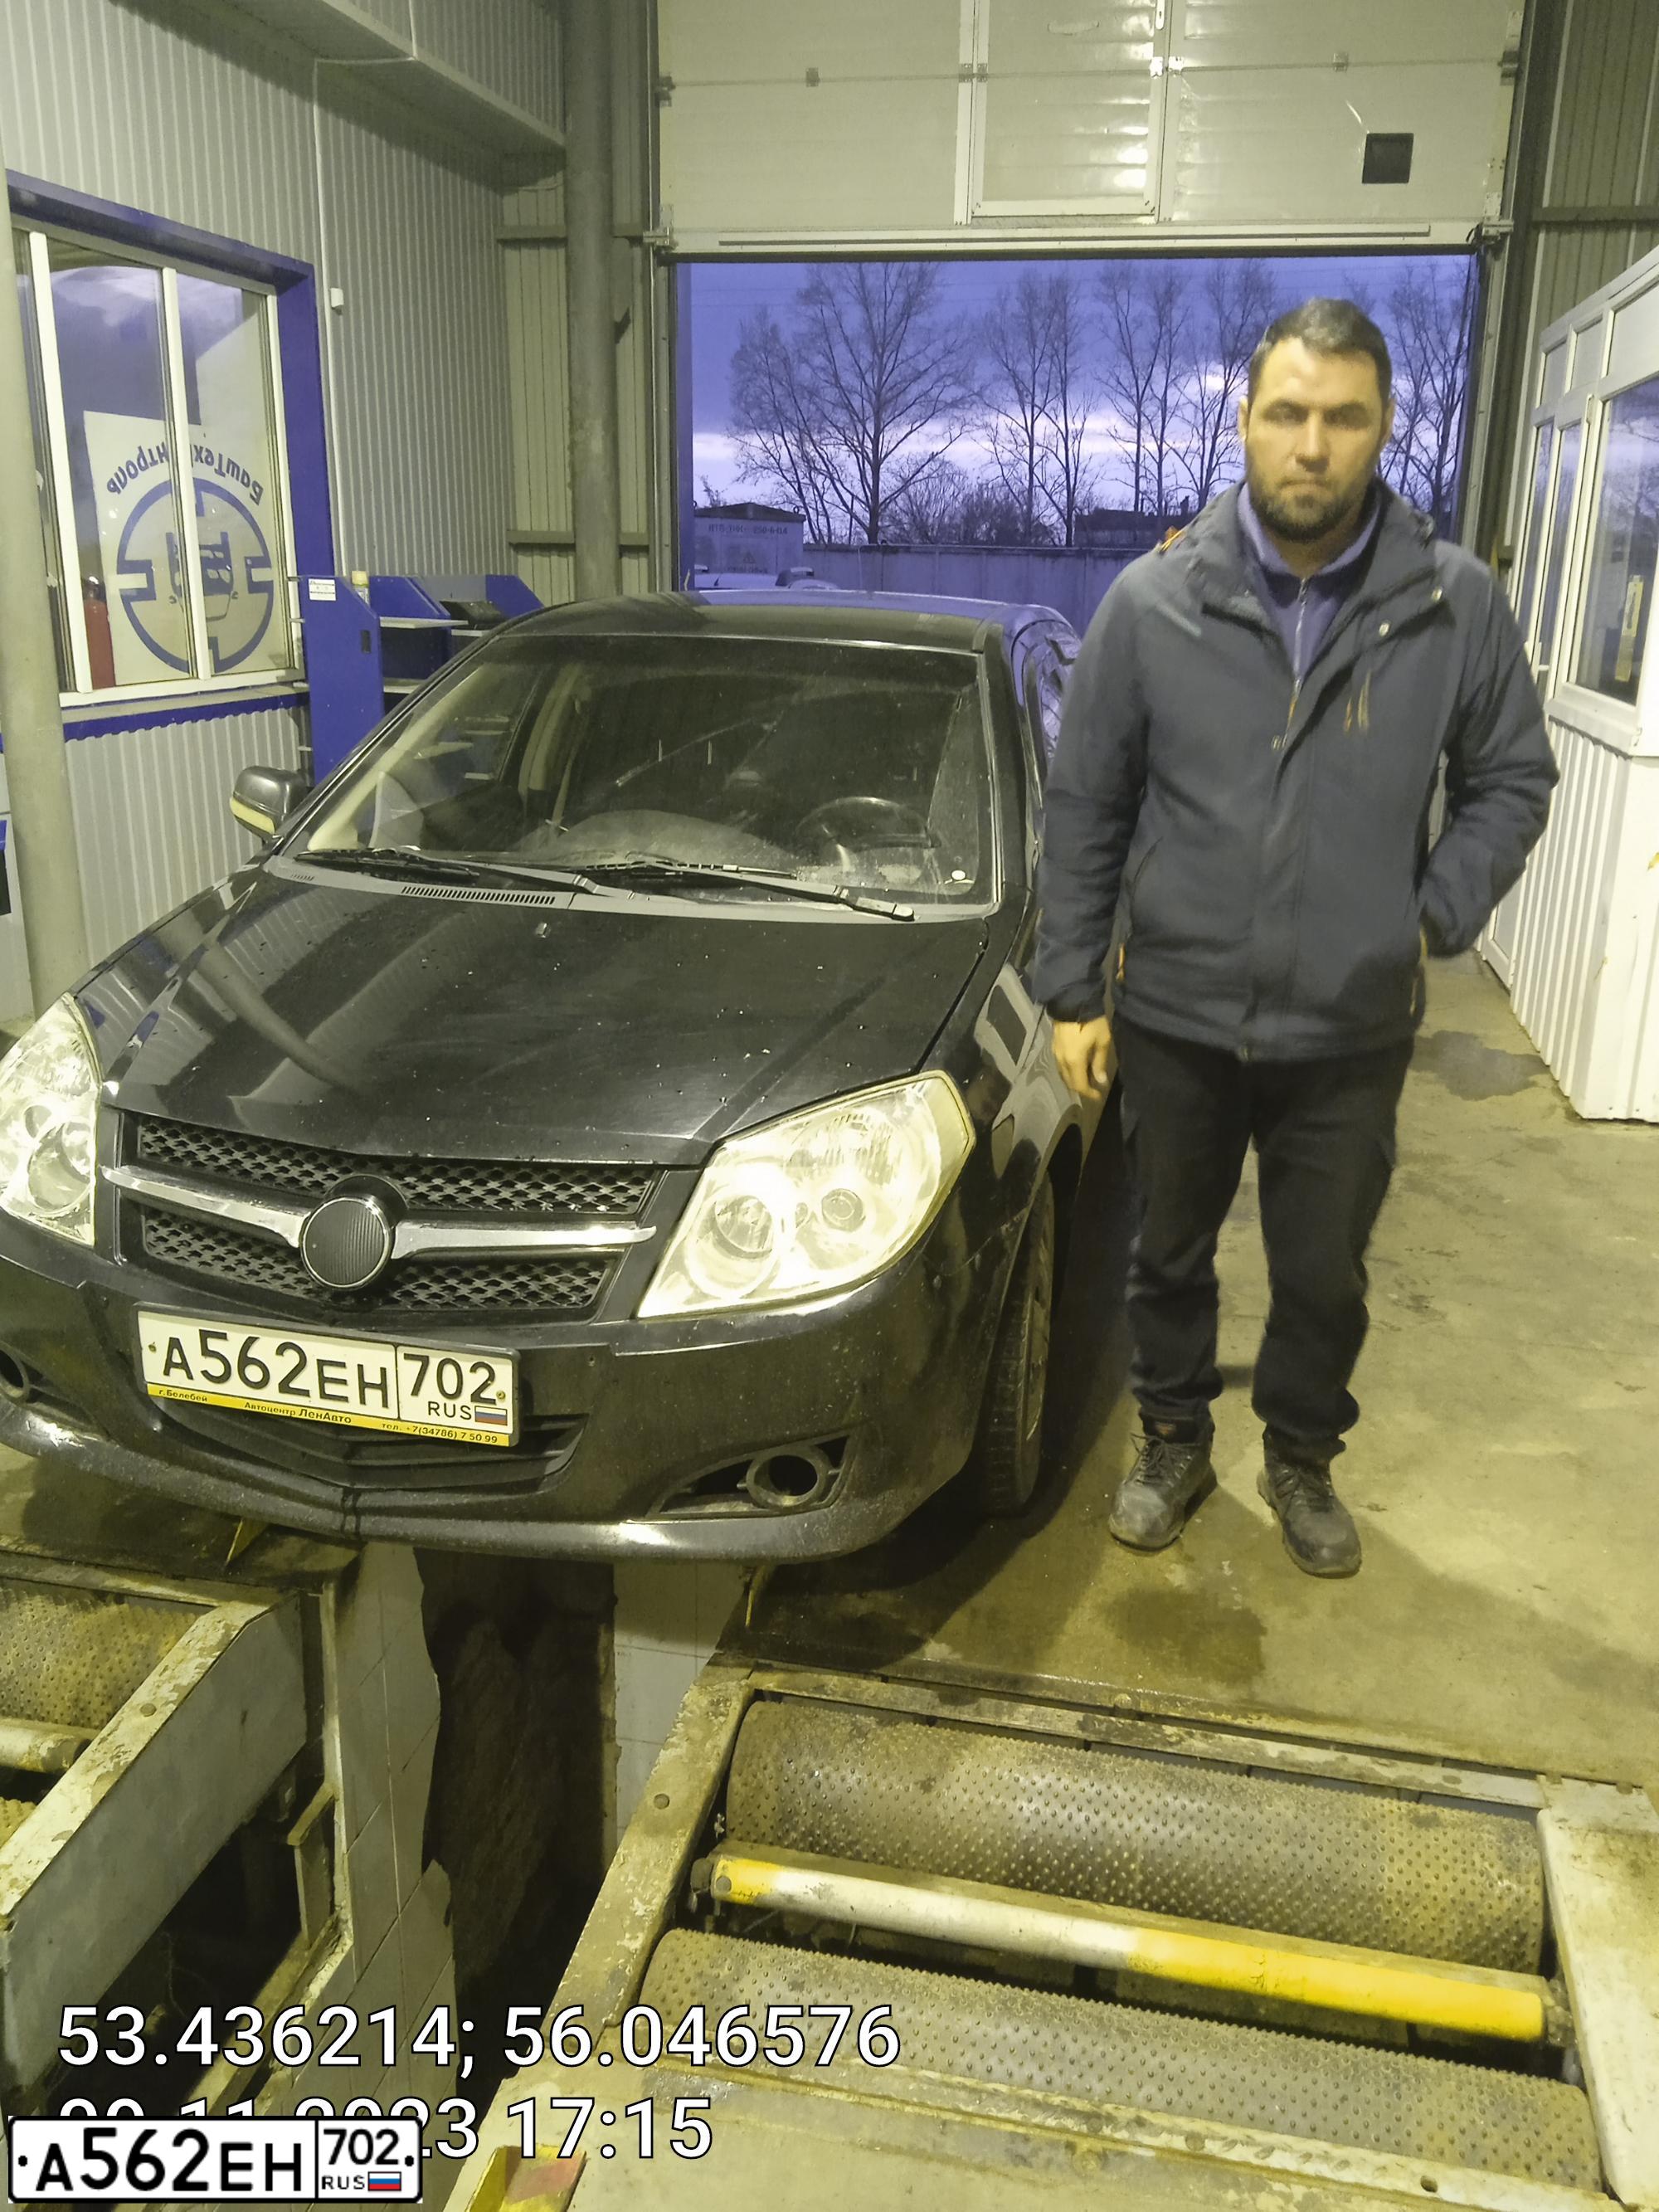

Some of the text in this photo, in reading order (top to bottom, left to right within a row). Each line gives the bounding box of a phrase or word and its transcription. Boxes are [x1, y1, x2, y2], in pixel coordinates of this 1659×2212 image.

[106, 441, 264, 506] БашТехнтроль
[163, 1328, 497, 1409] А562ЕН 702
[244, 1401, 352, 1425] Автоцентр ЛенАвто
[427, 1401, 472, 1420] RUS
[460, 1431, 467, 1440] 7
[469, 1433, 482, 1442] 50
[484, 1435, 498, 1444] 99
